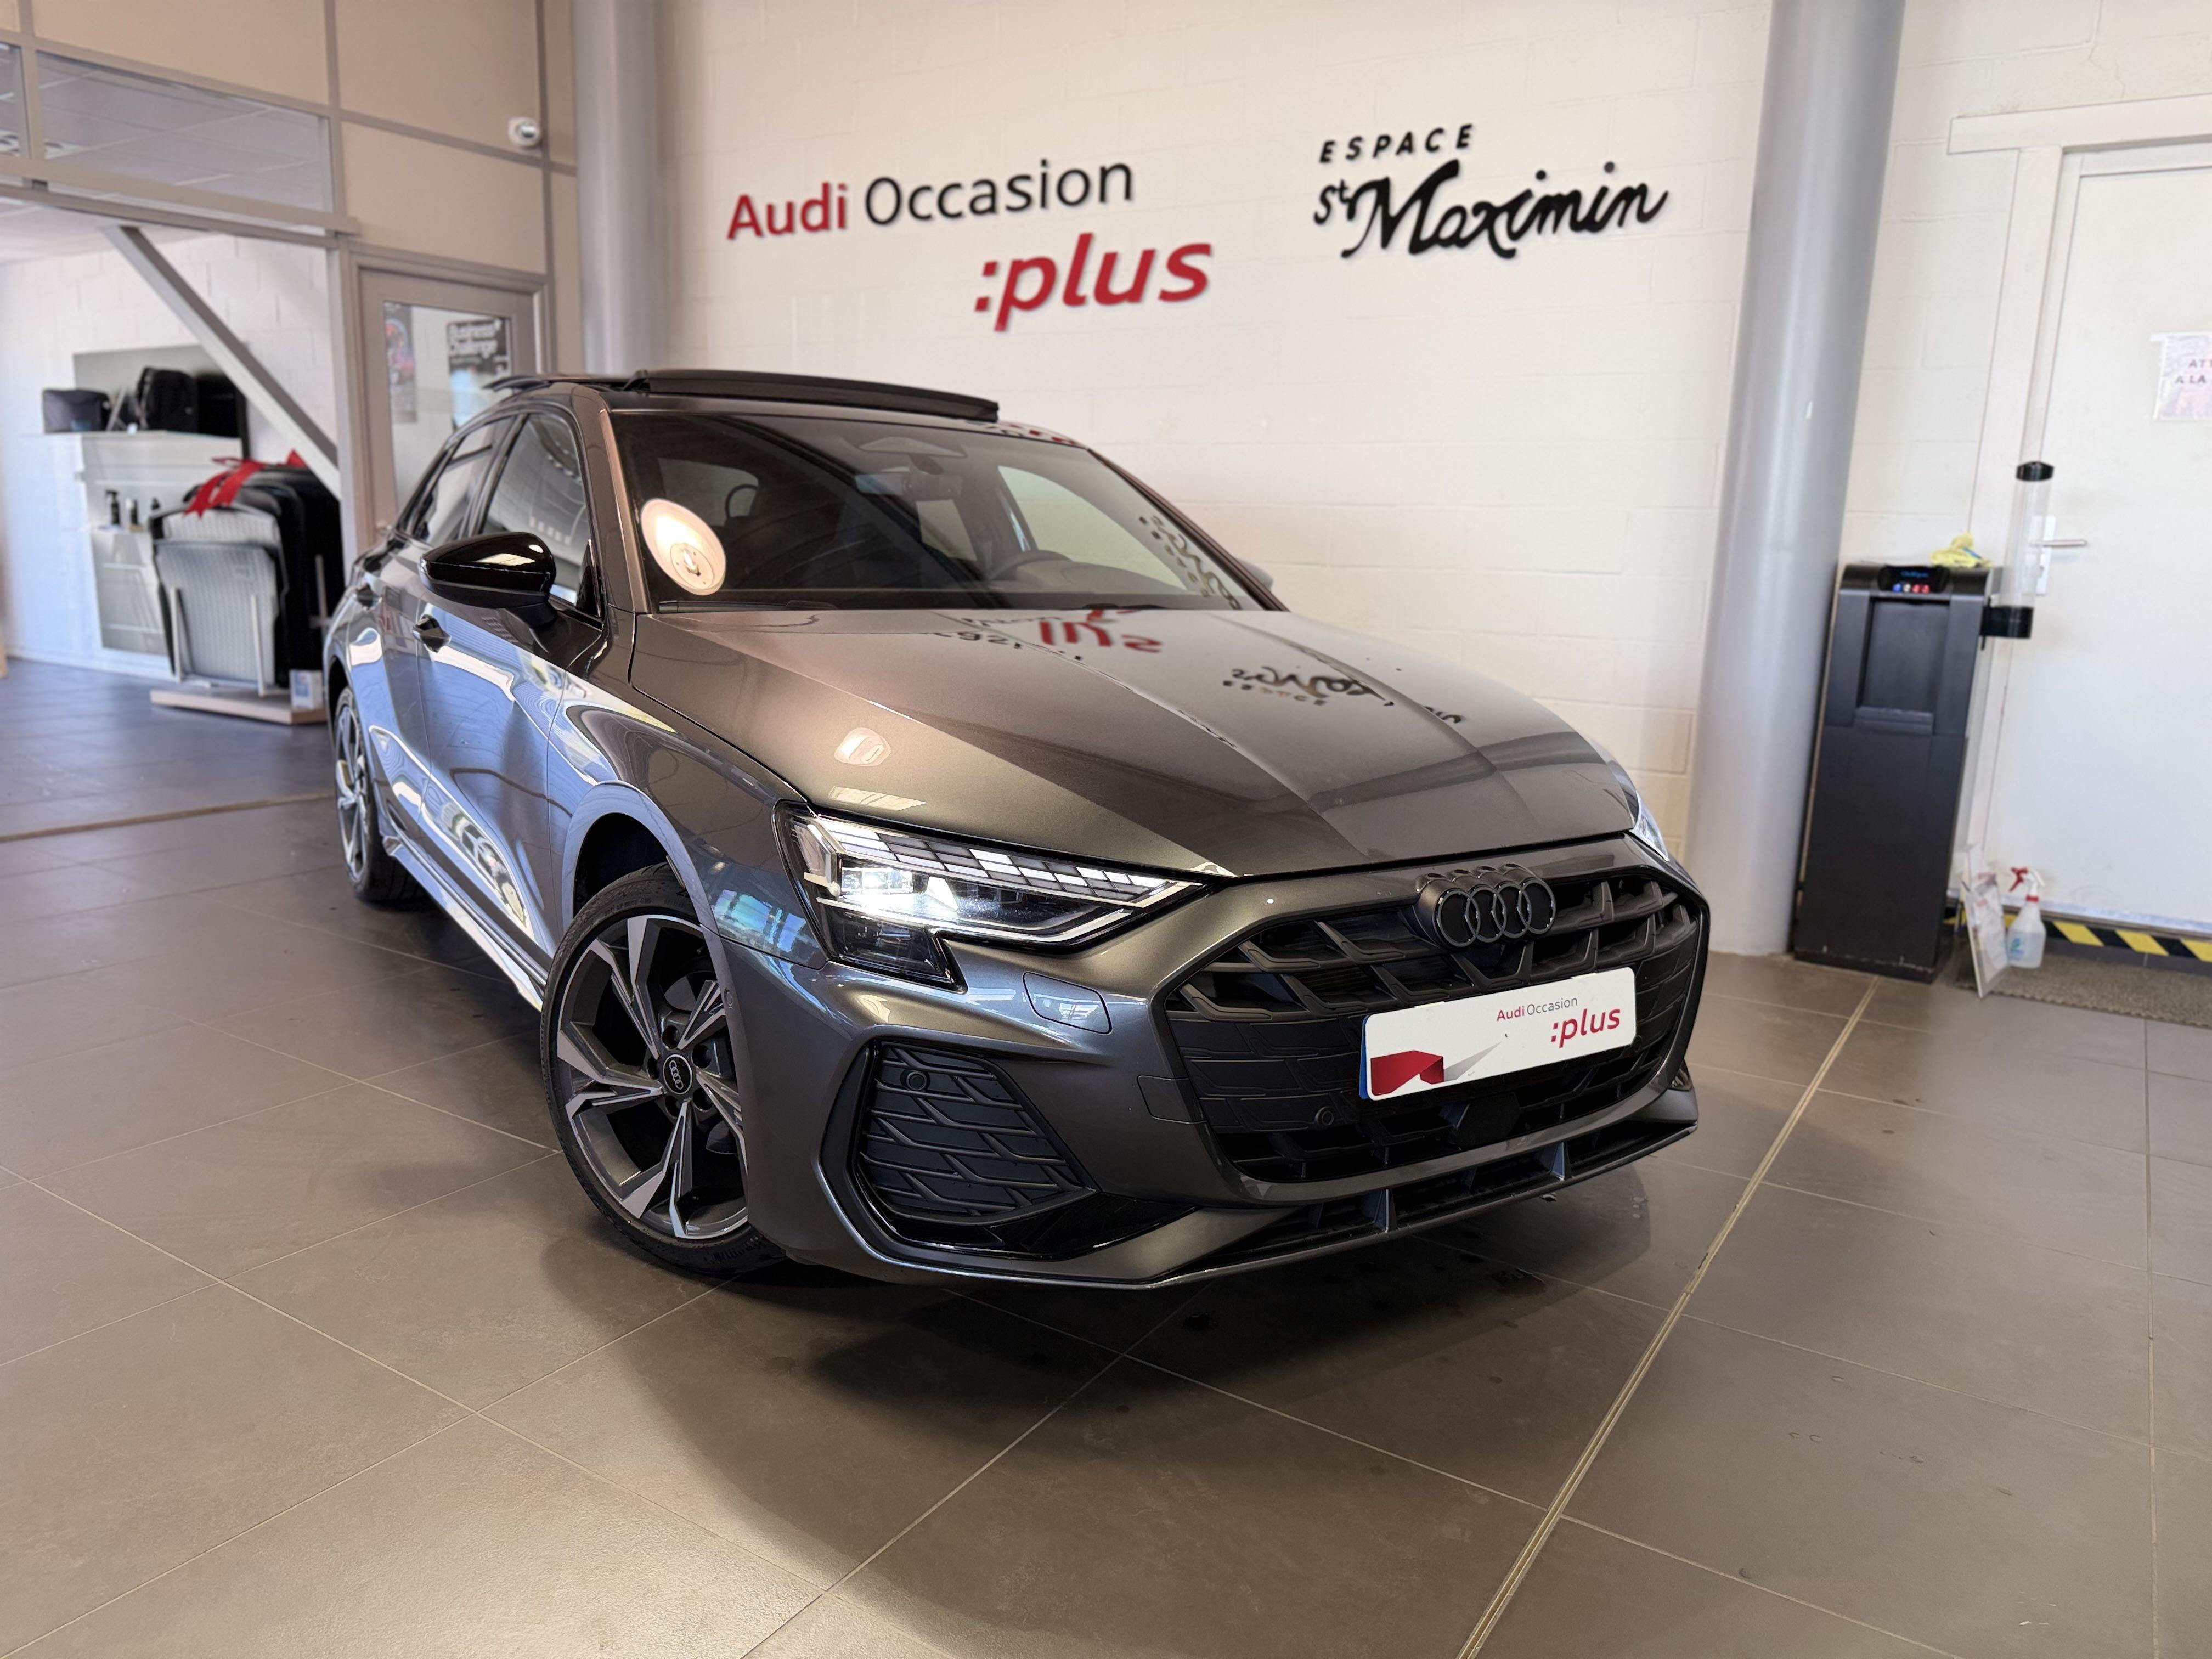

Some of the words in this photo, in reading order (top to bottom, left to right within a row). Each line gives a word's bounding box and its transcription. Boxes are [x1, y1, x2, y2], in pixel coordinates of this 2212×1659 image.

[1319, 123, 1473, 164] ESPACE
[726, 182, 847, 240] Audi
[865, 159, 1133, 226] Occasion
[1341, 158, 1669, 259] Maximin
[974, 232, 1212, 332] :plus
[2189, 375, 2207, 384] LA
[1496, 1006, 1525, 1022] Audi
[1527, 996, 1578, 1016] Occasion
[1550, 1008, 1621, 1049] :plus
